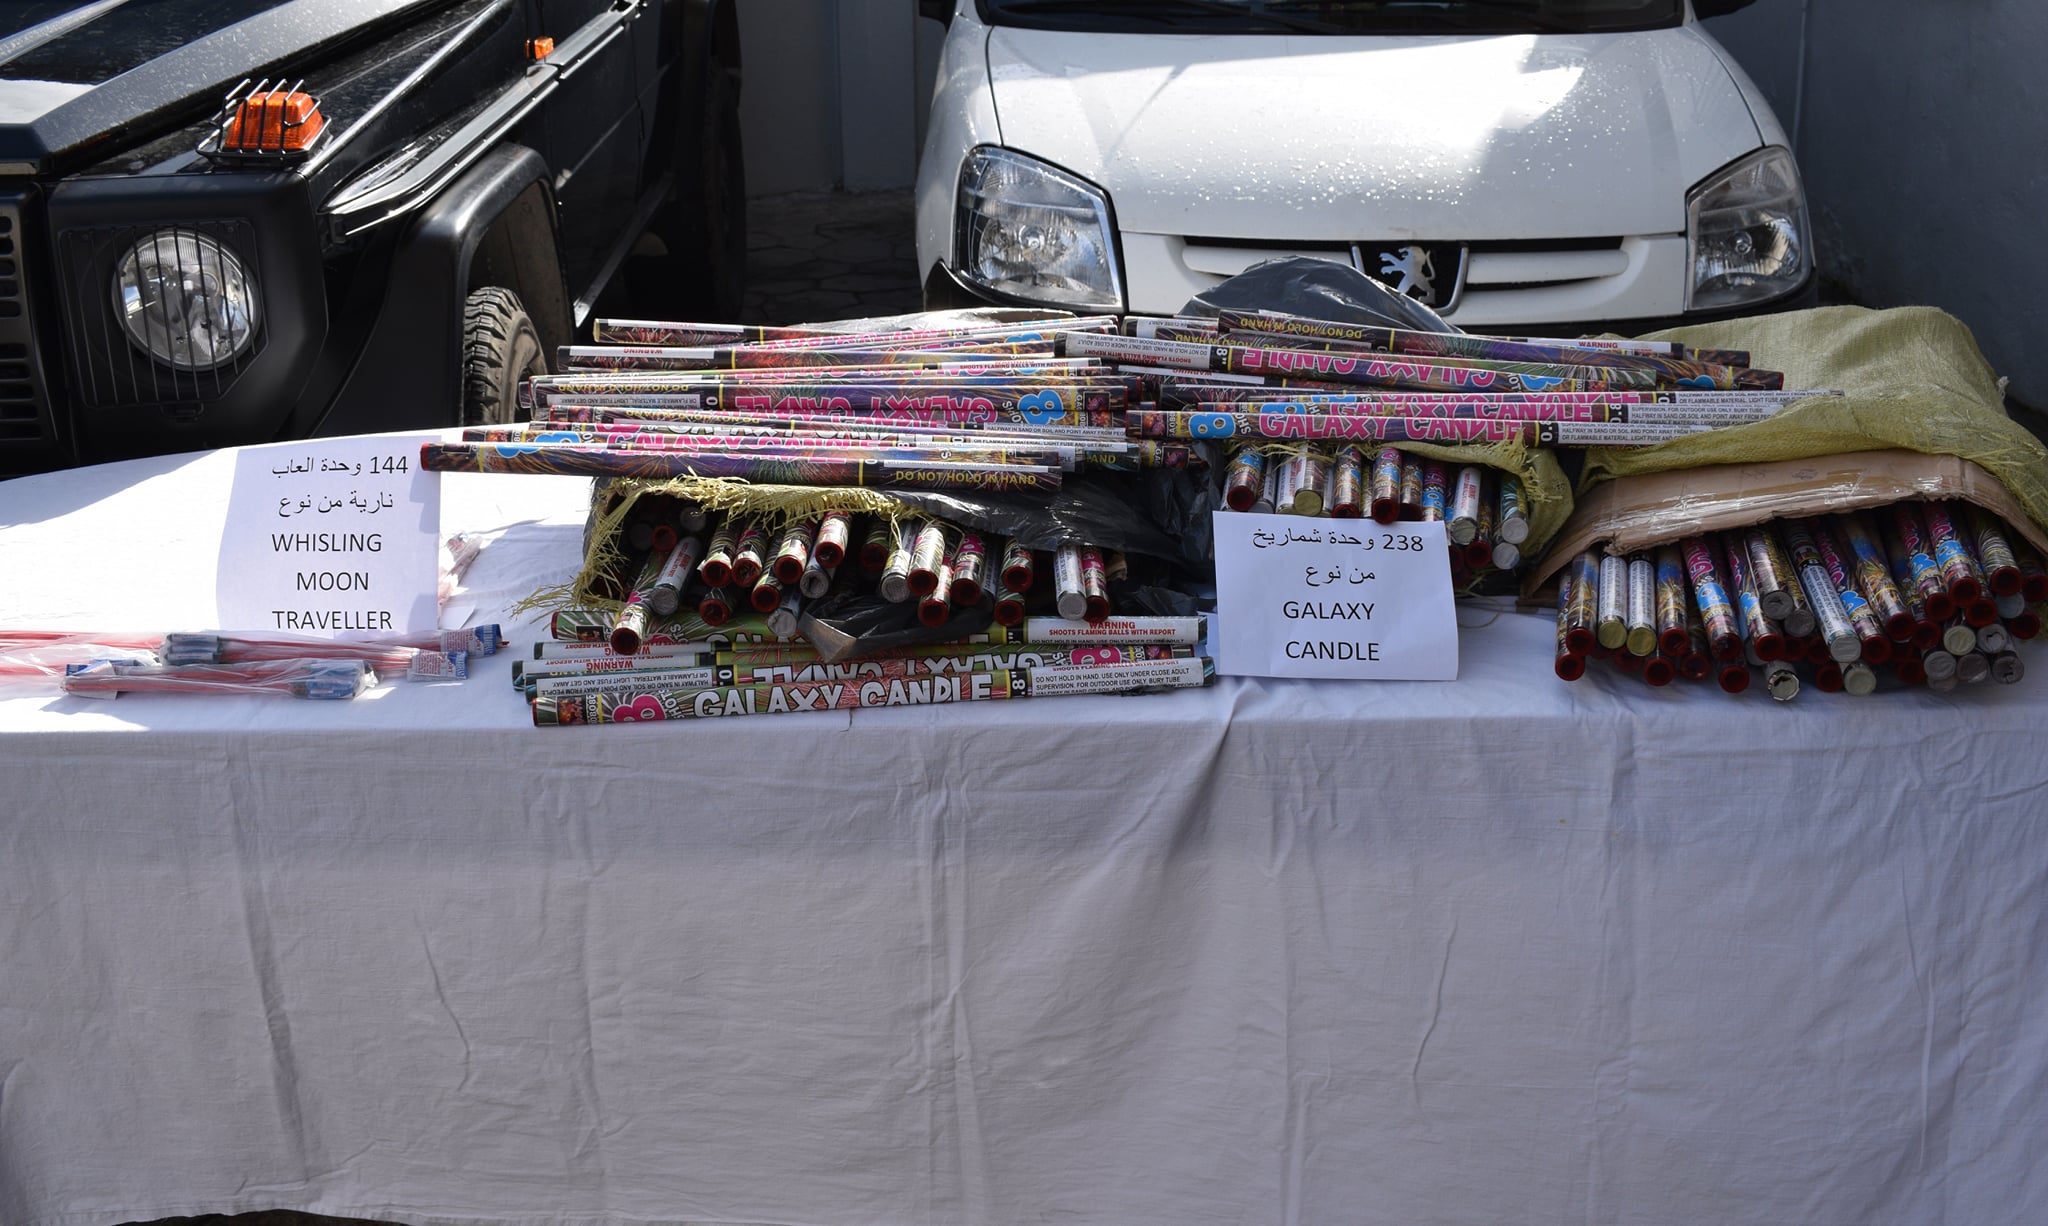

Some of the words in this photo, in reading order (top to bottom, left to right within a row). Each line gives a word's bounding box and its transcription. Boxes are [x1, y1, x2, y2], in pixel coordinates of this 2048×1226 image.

[1241, 318, 1272, 329] HAND
[1275, 322, 1284, 330] IN
[1289, 324, 1318, 334] HOLD
[1322, 327, 1343, 336] NOT
[1176, 334, 1207, 343] HAND
[1347, 330, 1362, 338] DO
[1259, 414, 1390, 440] GALAXY
[1404, 418, 1521, 442] CANDLE
[271, 456, 315, 479] العاب
[320, 457, 362, 476] وحدة
[370, 456, 409, 474] 144
[896, 471, 914, 481] DO
[918, 472, 943, 482] NOT
[946, 473, 980, 483] HOLD
[986, 474, 997, 484] IN
[1002, 475, 1037, 485] HAND
[278, 494, 312, 518] نوع
[317, 495, 343, 514] من
[349, 490, 394, 514] نارية
[272, 533, 383, 552] WHISLING
[1252, 527, 1323, 549] شماريخ
[1329, 530, 1375, 551] وحدة
[1382, 533, 1424, 552] 238
[296, 572, 370, 591] MOON
[1305, 564, 1341, 587] نوع
[1349, 569, 1376, 585] من
[272, 611, 393, 630] TRAVELLER
[1283, 601, 1376, 621] GALAXY
[1285, 641, 1380, 661] CANDLE
[586, 660, 634, 671] WARNING
[663, 673, 698, 681] FLAMMABLE
[694, 684, 844, 718] GALAXY
[860, 674, 993, 707] CANDLE
